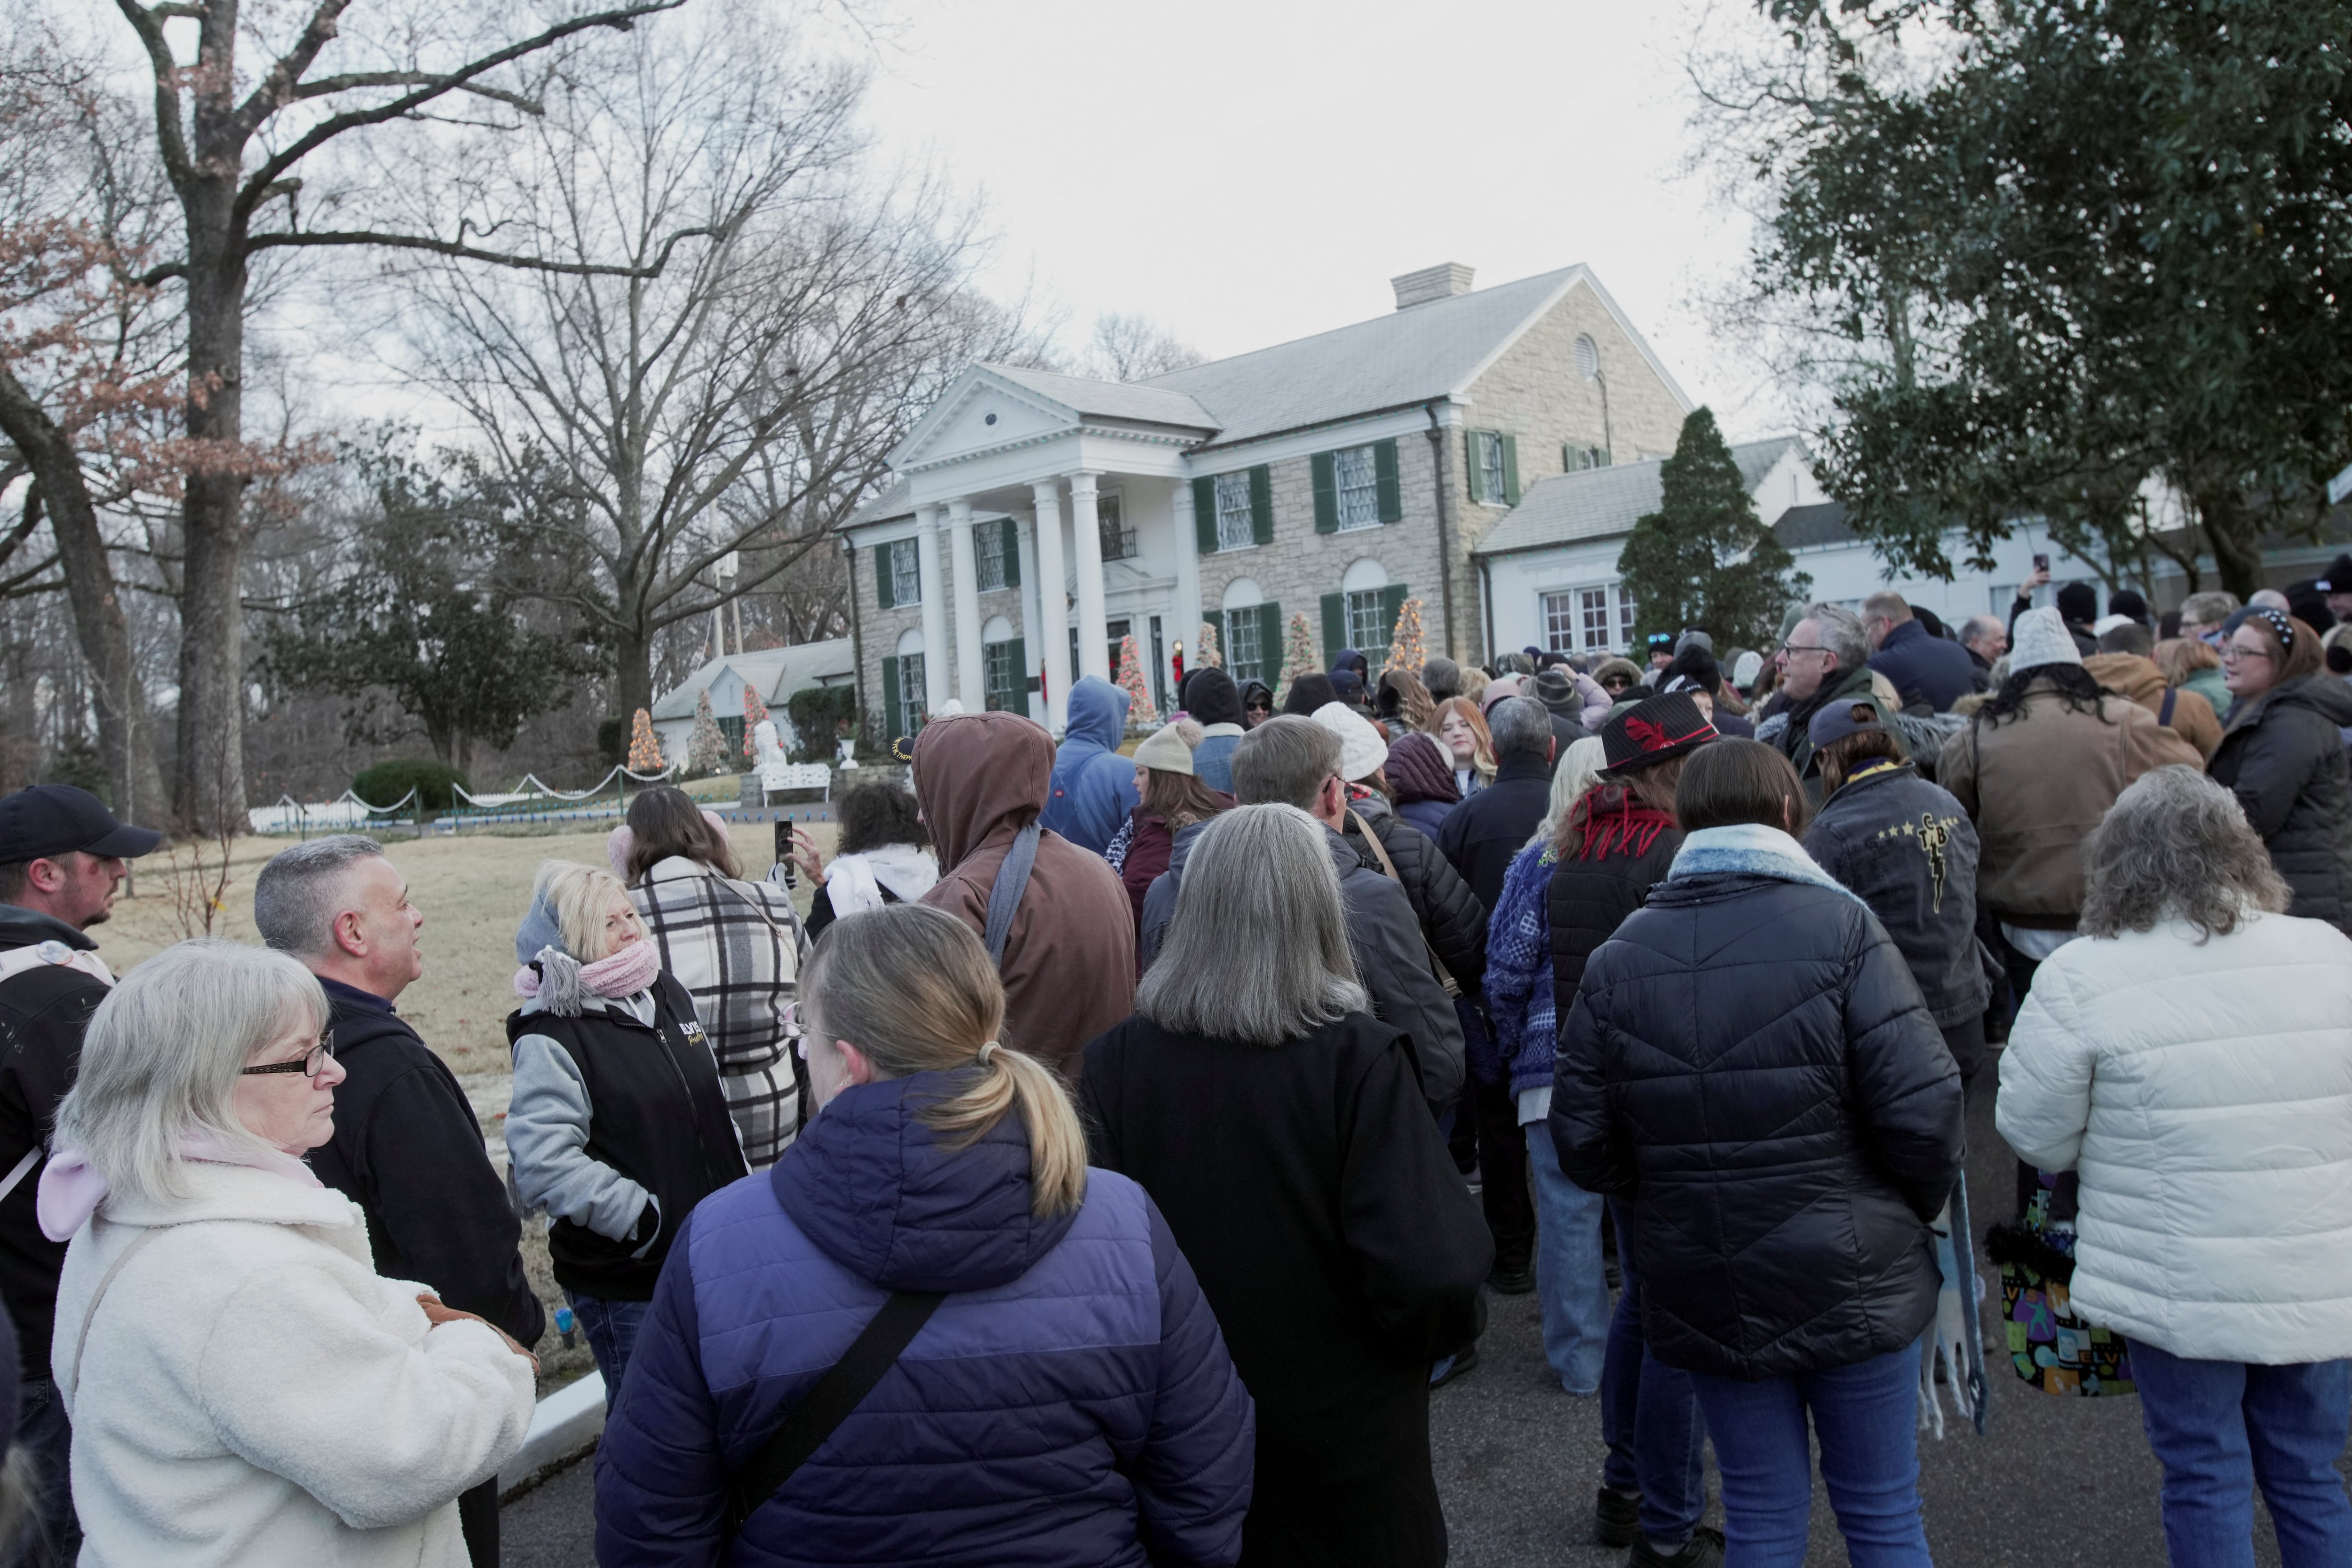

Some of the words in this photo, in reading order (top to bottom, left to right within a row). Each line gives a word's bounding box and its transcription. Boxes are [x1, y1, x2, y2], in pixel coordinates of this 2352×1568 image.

[679, 1021, 701, 1035] ELVIS
[2002, 1284, 2038, 1302] LVIS
[2079, 1350, 2126, 1364] ELVI
